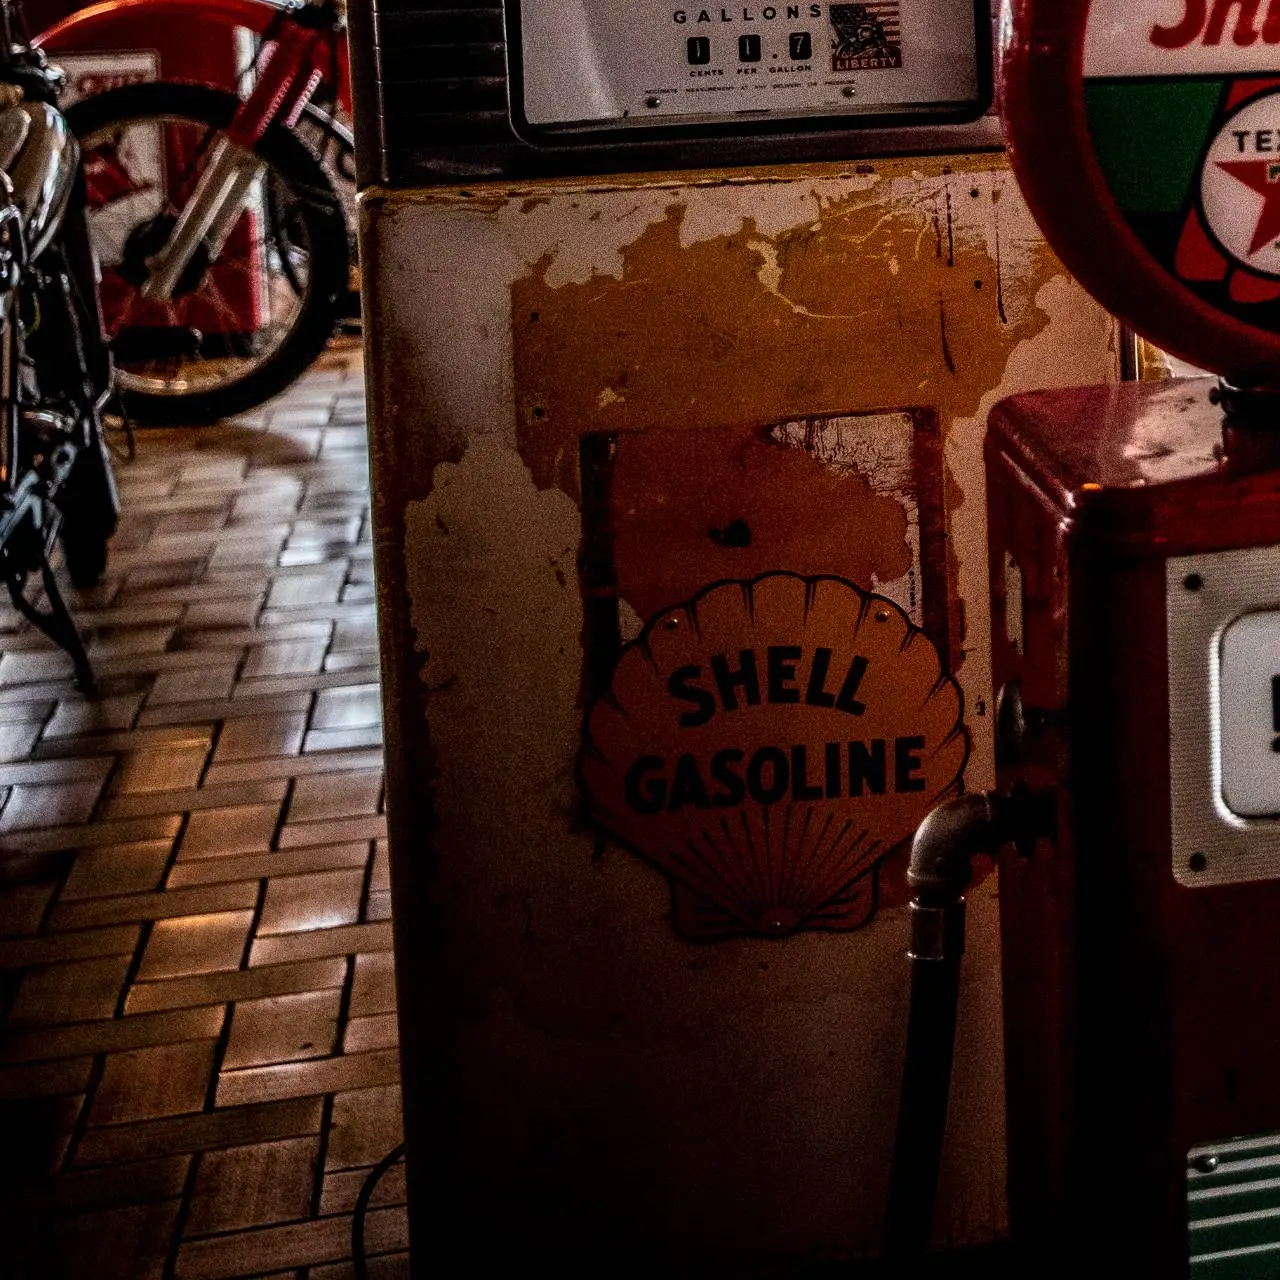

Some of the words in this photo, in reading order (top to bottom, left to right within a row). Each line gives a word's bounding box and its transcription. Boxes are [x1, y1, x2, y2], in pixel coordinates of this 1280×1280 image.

[673, 3, 822, 24] GALLONS
[689, 69, 723, 77] CENTS
[737, 67, 757, 75] PER
[769, 65, 811, 74] GALLON
[836, 57, 896, 70] LIBERTY
[668, 646, 870, 727] SHELL
[623, 735, 925, 815] GASOLINE
